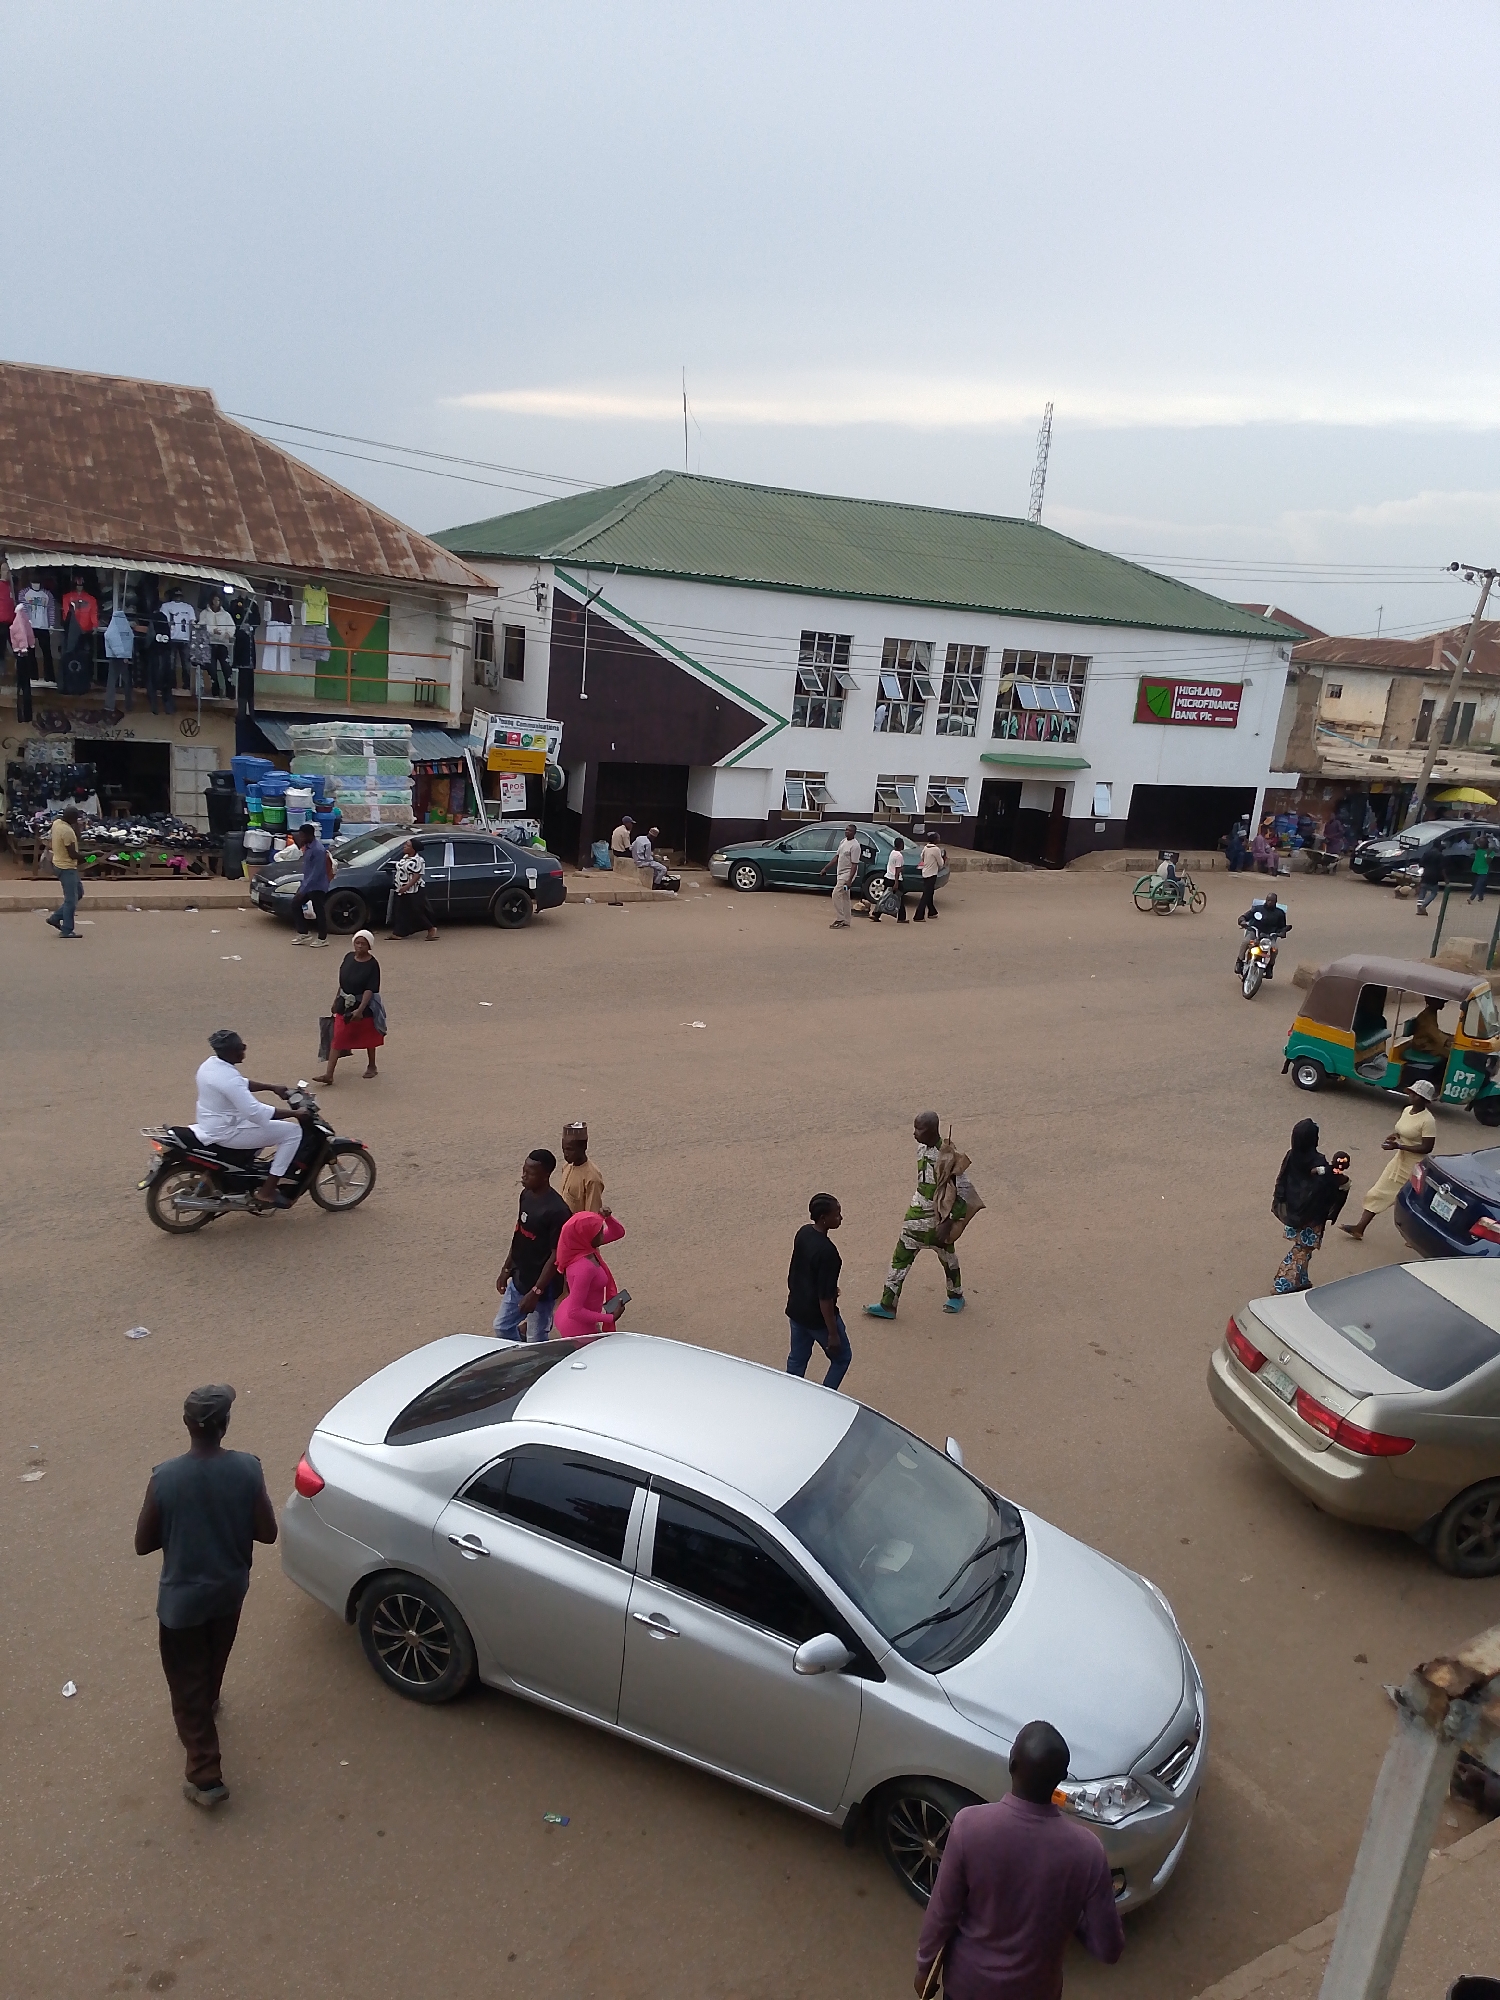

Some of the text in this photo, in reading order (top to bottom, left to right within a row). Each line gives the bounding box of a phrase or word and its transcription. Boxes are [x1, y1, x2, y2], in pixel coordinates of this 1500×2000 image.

[1179, 685, 1222, 698] HIGHLAND
[1176, 698, 1239, 711] MICROFINANCE
[1175, 710, 1198, 720] BANK
[509, 783, 525, 791] POS
